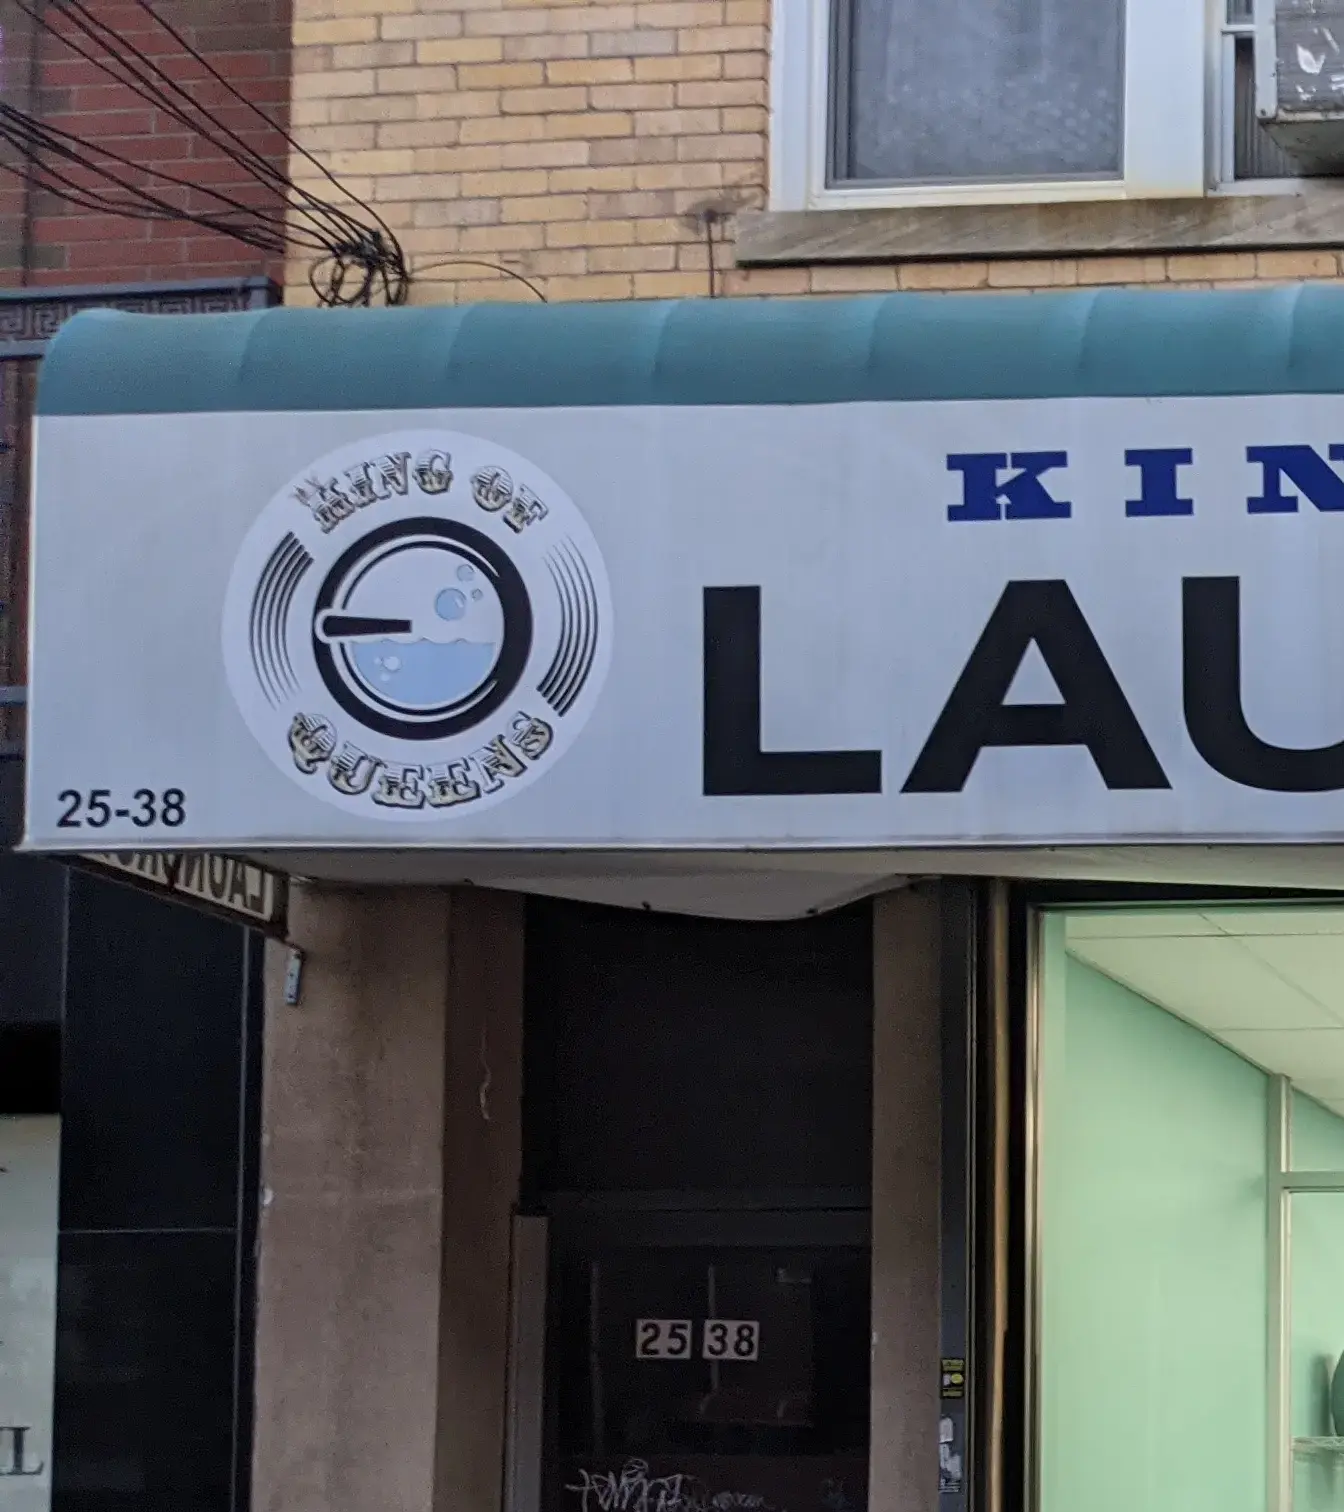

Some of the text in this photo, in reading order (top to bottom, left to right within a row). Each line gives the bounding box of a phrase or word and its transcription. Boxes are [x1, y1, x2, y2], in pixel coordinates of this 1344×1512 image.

[313, 449, 549, 534] KING OF
[288, 711, 555, 809] QUEENS
[57, 788, 187, 829] 25-38
[639, 1322, 757, 1356] 25 38
[0, 1427, 46, 1476] L
